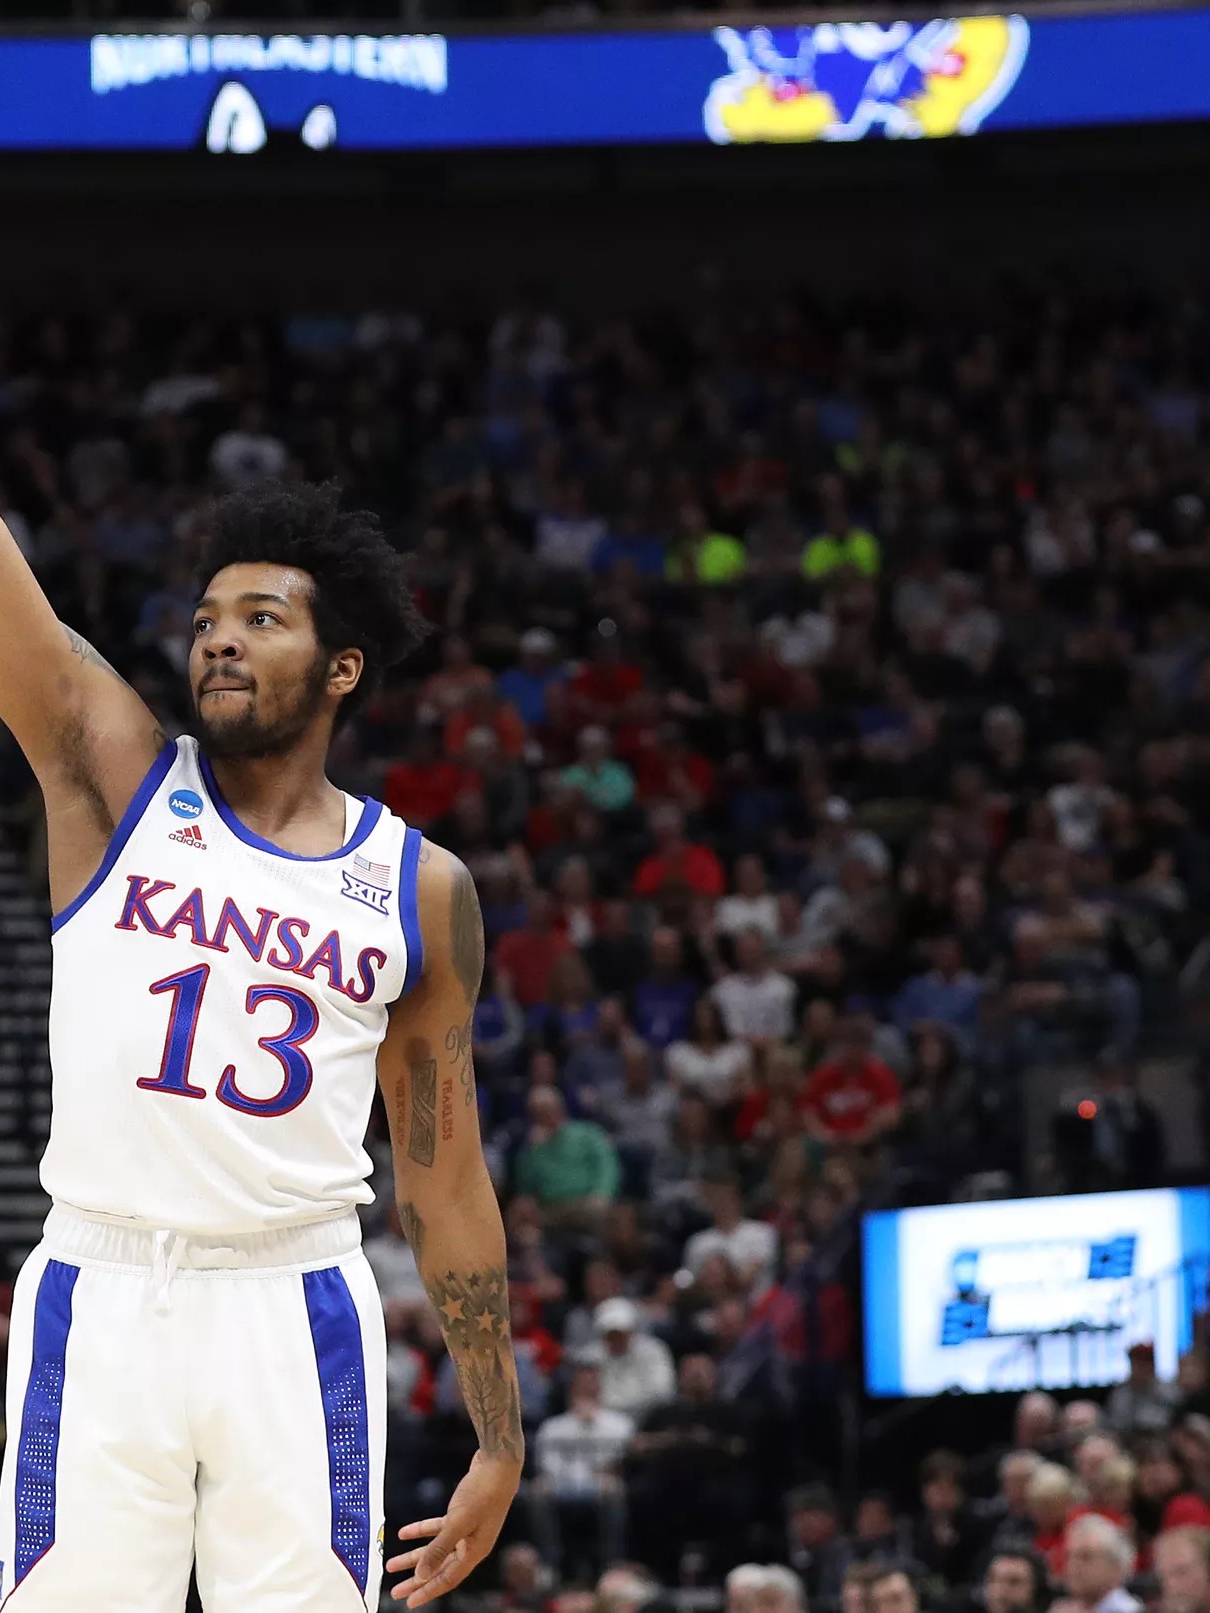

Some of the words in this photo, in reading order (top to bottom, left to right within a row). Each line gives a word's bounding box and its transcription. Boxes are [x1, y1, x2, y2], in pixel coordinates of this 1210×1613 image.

[168, 833, 208, 850] adidas
[171, 798, 201, 816] NCAA
[115, 874, 387, 1004] KANSAS
[136, 963, 320, 1118] 13
